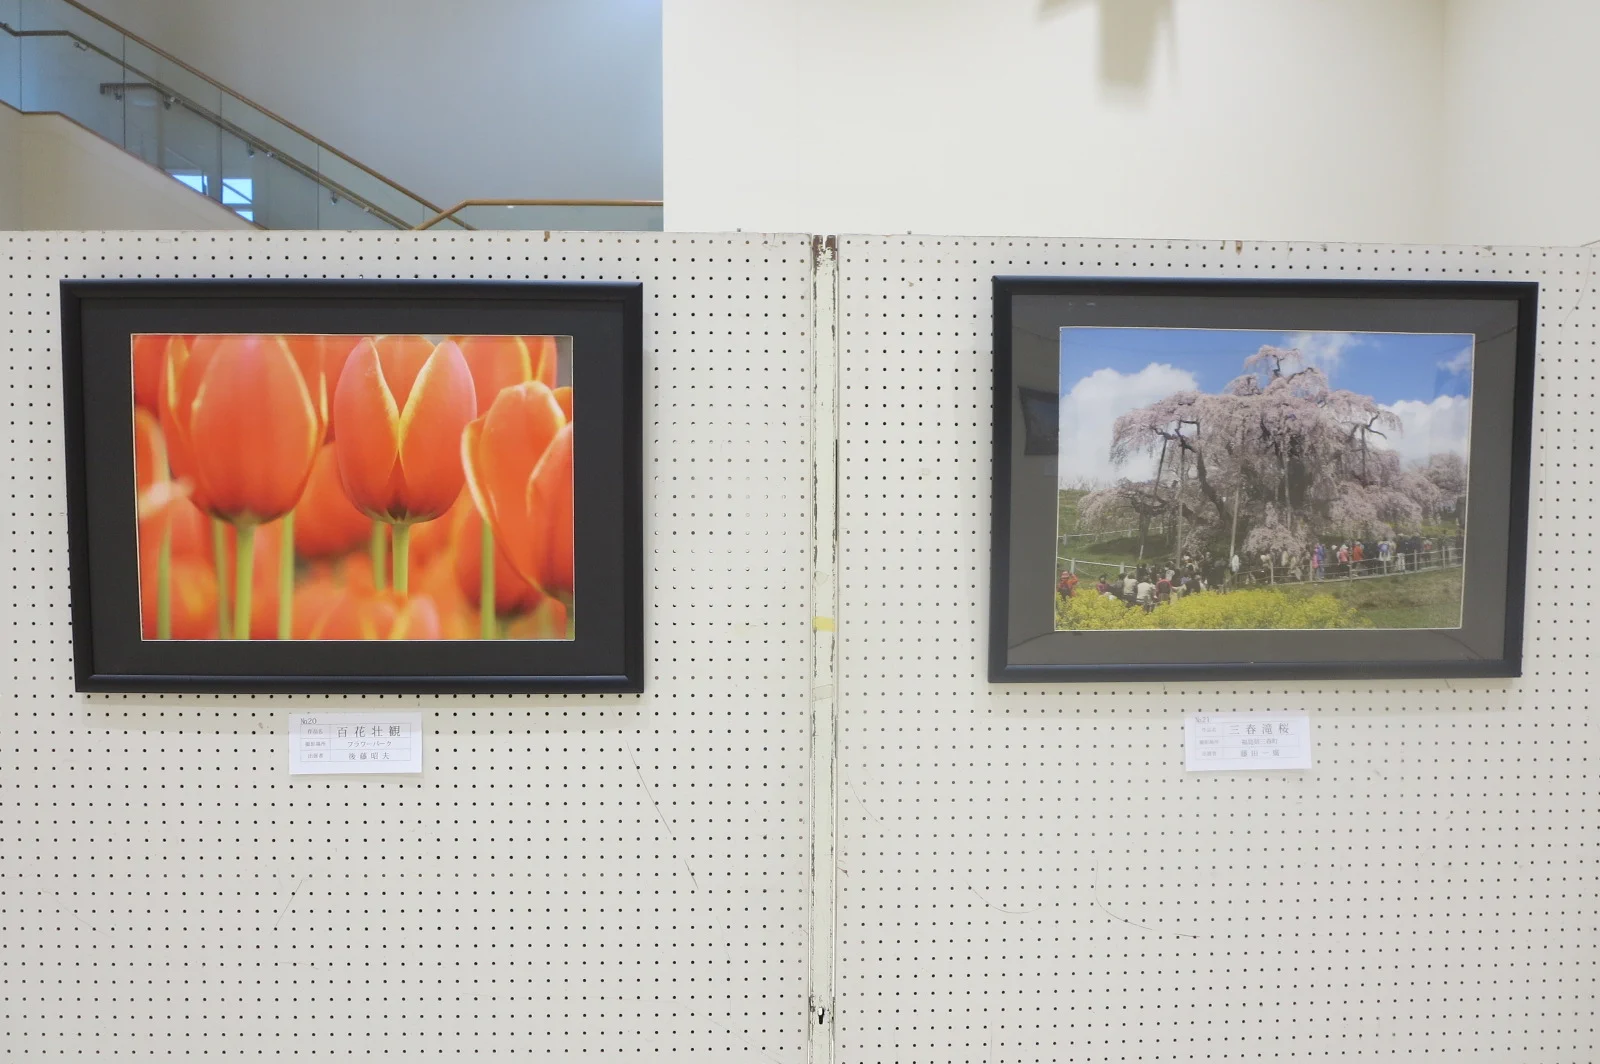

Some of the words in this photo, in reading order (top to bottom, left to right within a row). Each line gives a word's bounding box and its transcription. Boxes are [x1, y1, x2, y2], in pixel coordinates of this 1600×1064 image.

[336, 725, 401, 738] 百花壮観
[347, 740, 392, 748] フラワーパーク
[348, 751, 390, 761] 後藤昭夫
